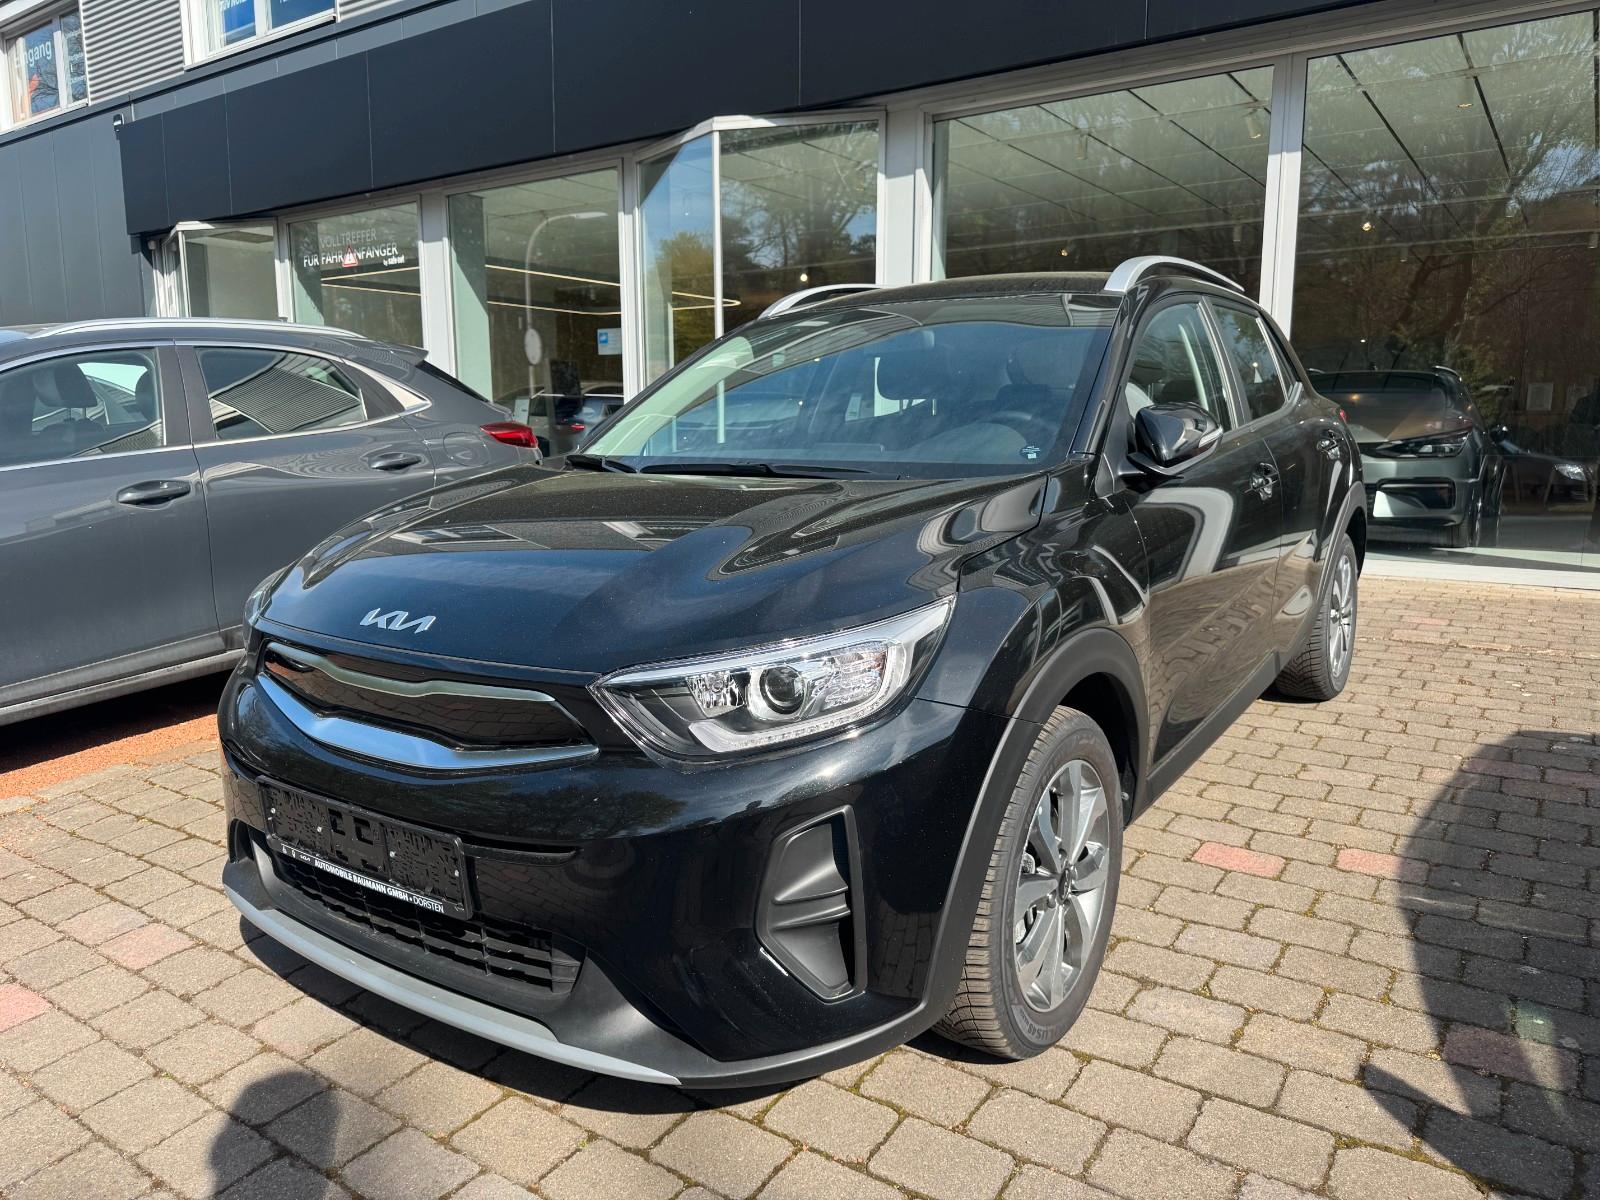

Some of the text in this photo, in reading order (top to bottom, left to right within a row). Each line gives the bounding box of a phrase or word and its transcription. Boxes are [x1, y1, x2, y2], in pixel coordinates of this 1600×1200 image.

[320, 228, 376, 248] VOLLTREFFER
[360, 607, 436, 634] KIA
[314, 859, 444, 914] AUTOMOBILE BAUMANN GMBH DORSTEN
